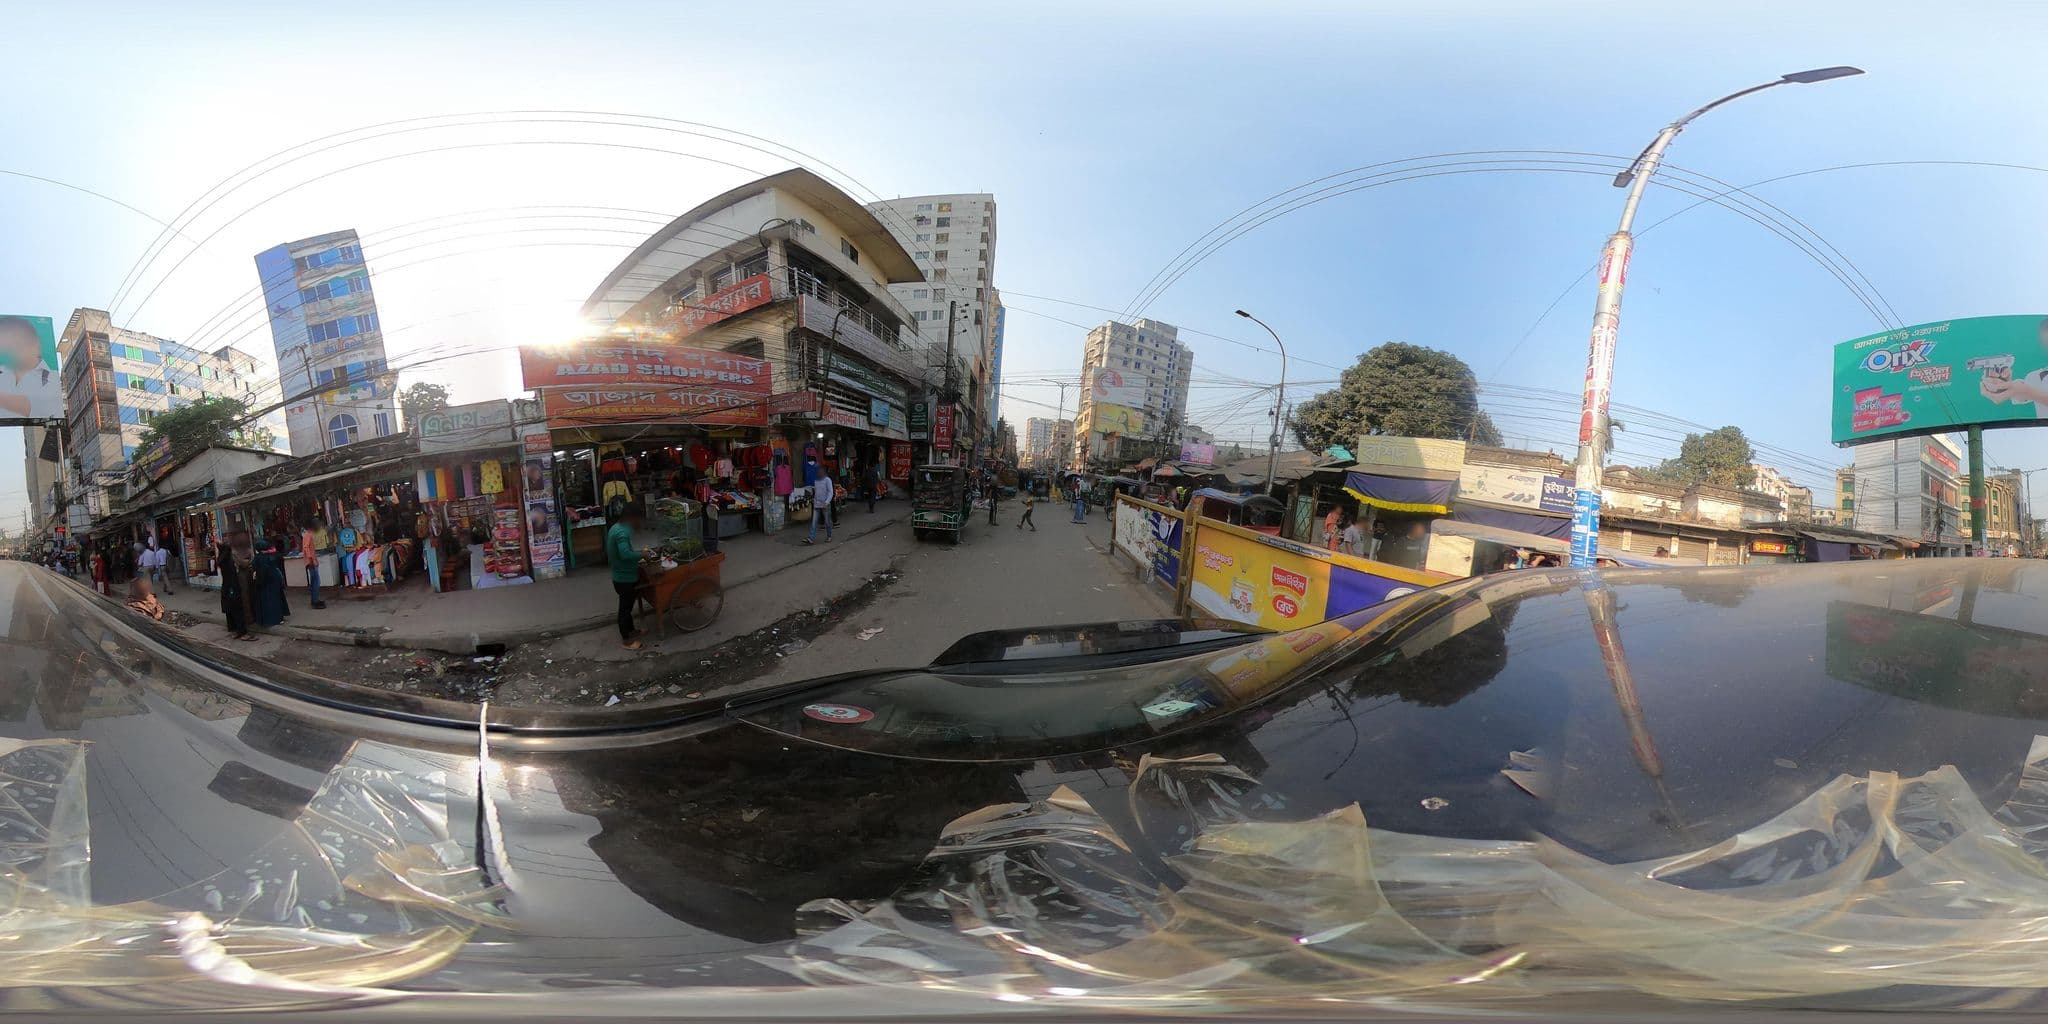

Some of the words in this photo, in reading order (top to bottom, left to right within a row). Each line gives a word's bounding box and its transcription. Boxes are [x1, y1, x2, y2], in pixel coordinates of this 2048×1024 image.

[1864, 341, 1930, 371] Orix
[556, 362, 630, 376] AZAD
[636, 363, 754, 386] SHOPPERS
[563, 390, 657, 406] আজাদ
[1275, 599, 1294, 615] ব্রেড
